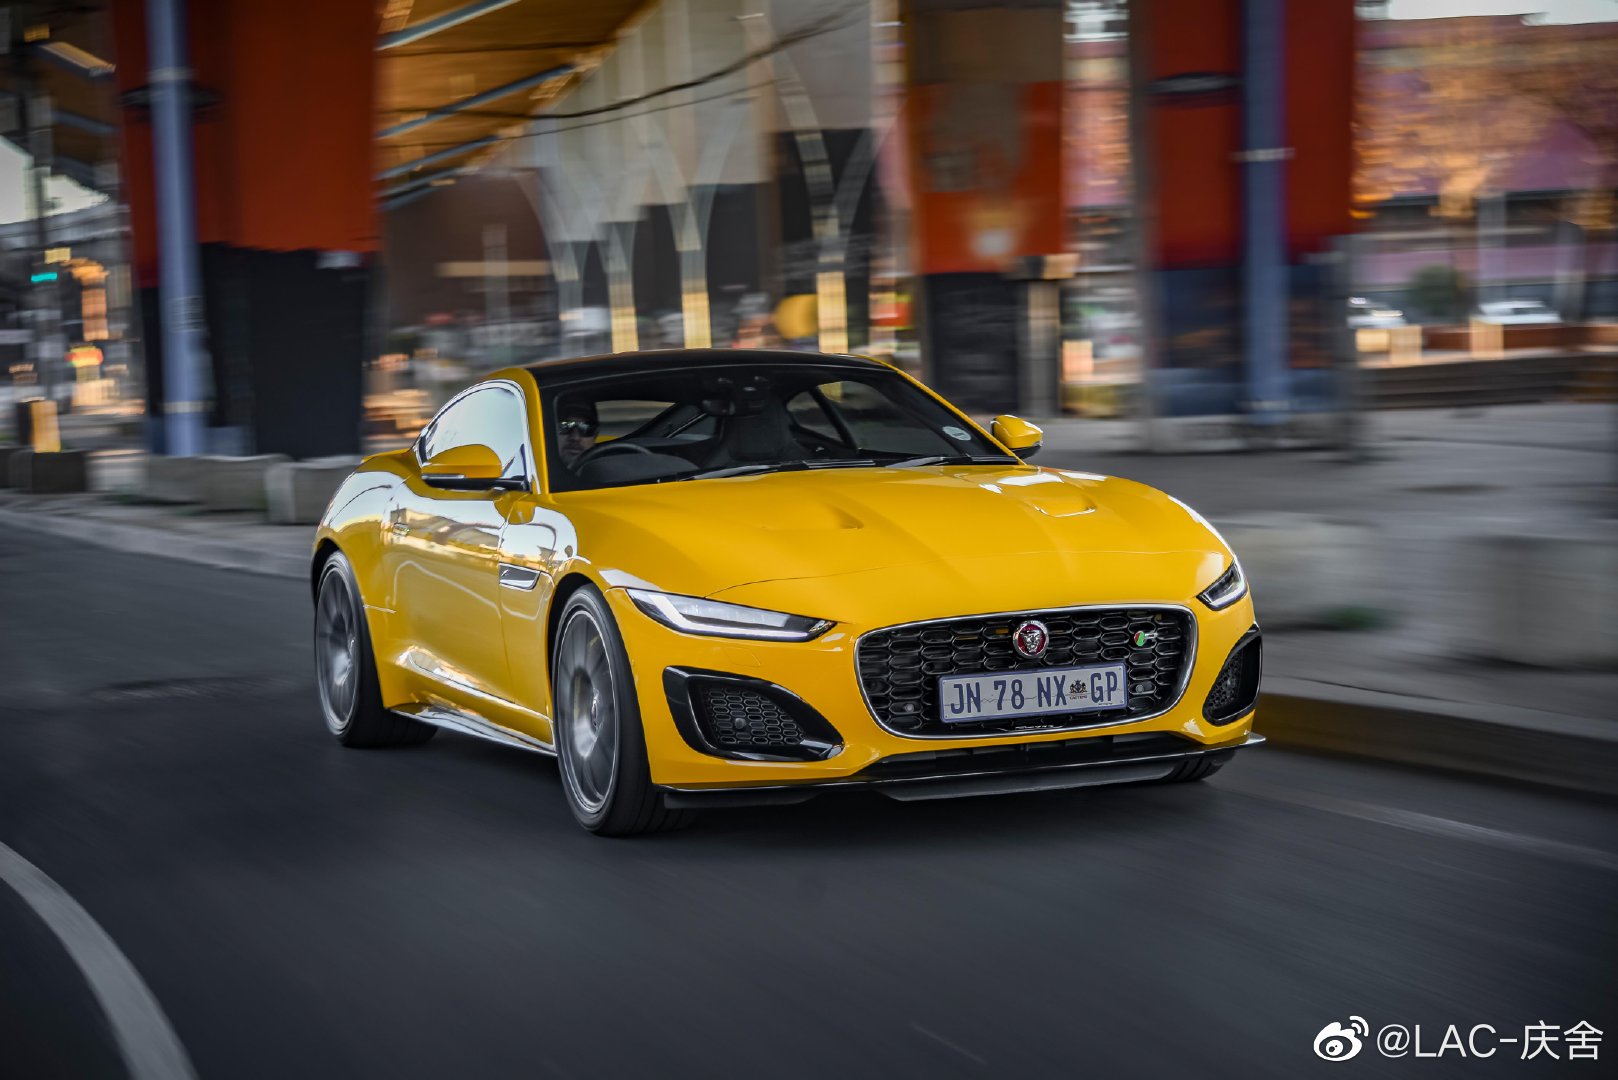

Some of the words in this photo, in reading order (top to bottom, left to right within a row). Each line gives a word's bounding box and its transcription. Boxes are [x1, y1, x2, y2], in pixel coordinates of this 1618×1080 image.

[950, 682, 981, 715] JN
[993, 679, 1025, 711] 78
[1037, 675, 1067, 708] NX
[1090, 671, 1118, 704] GP
